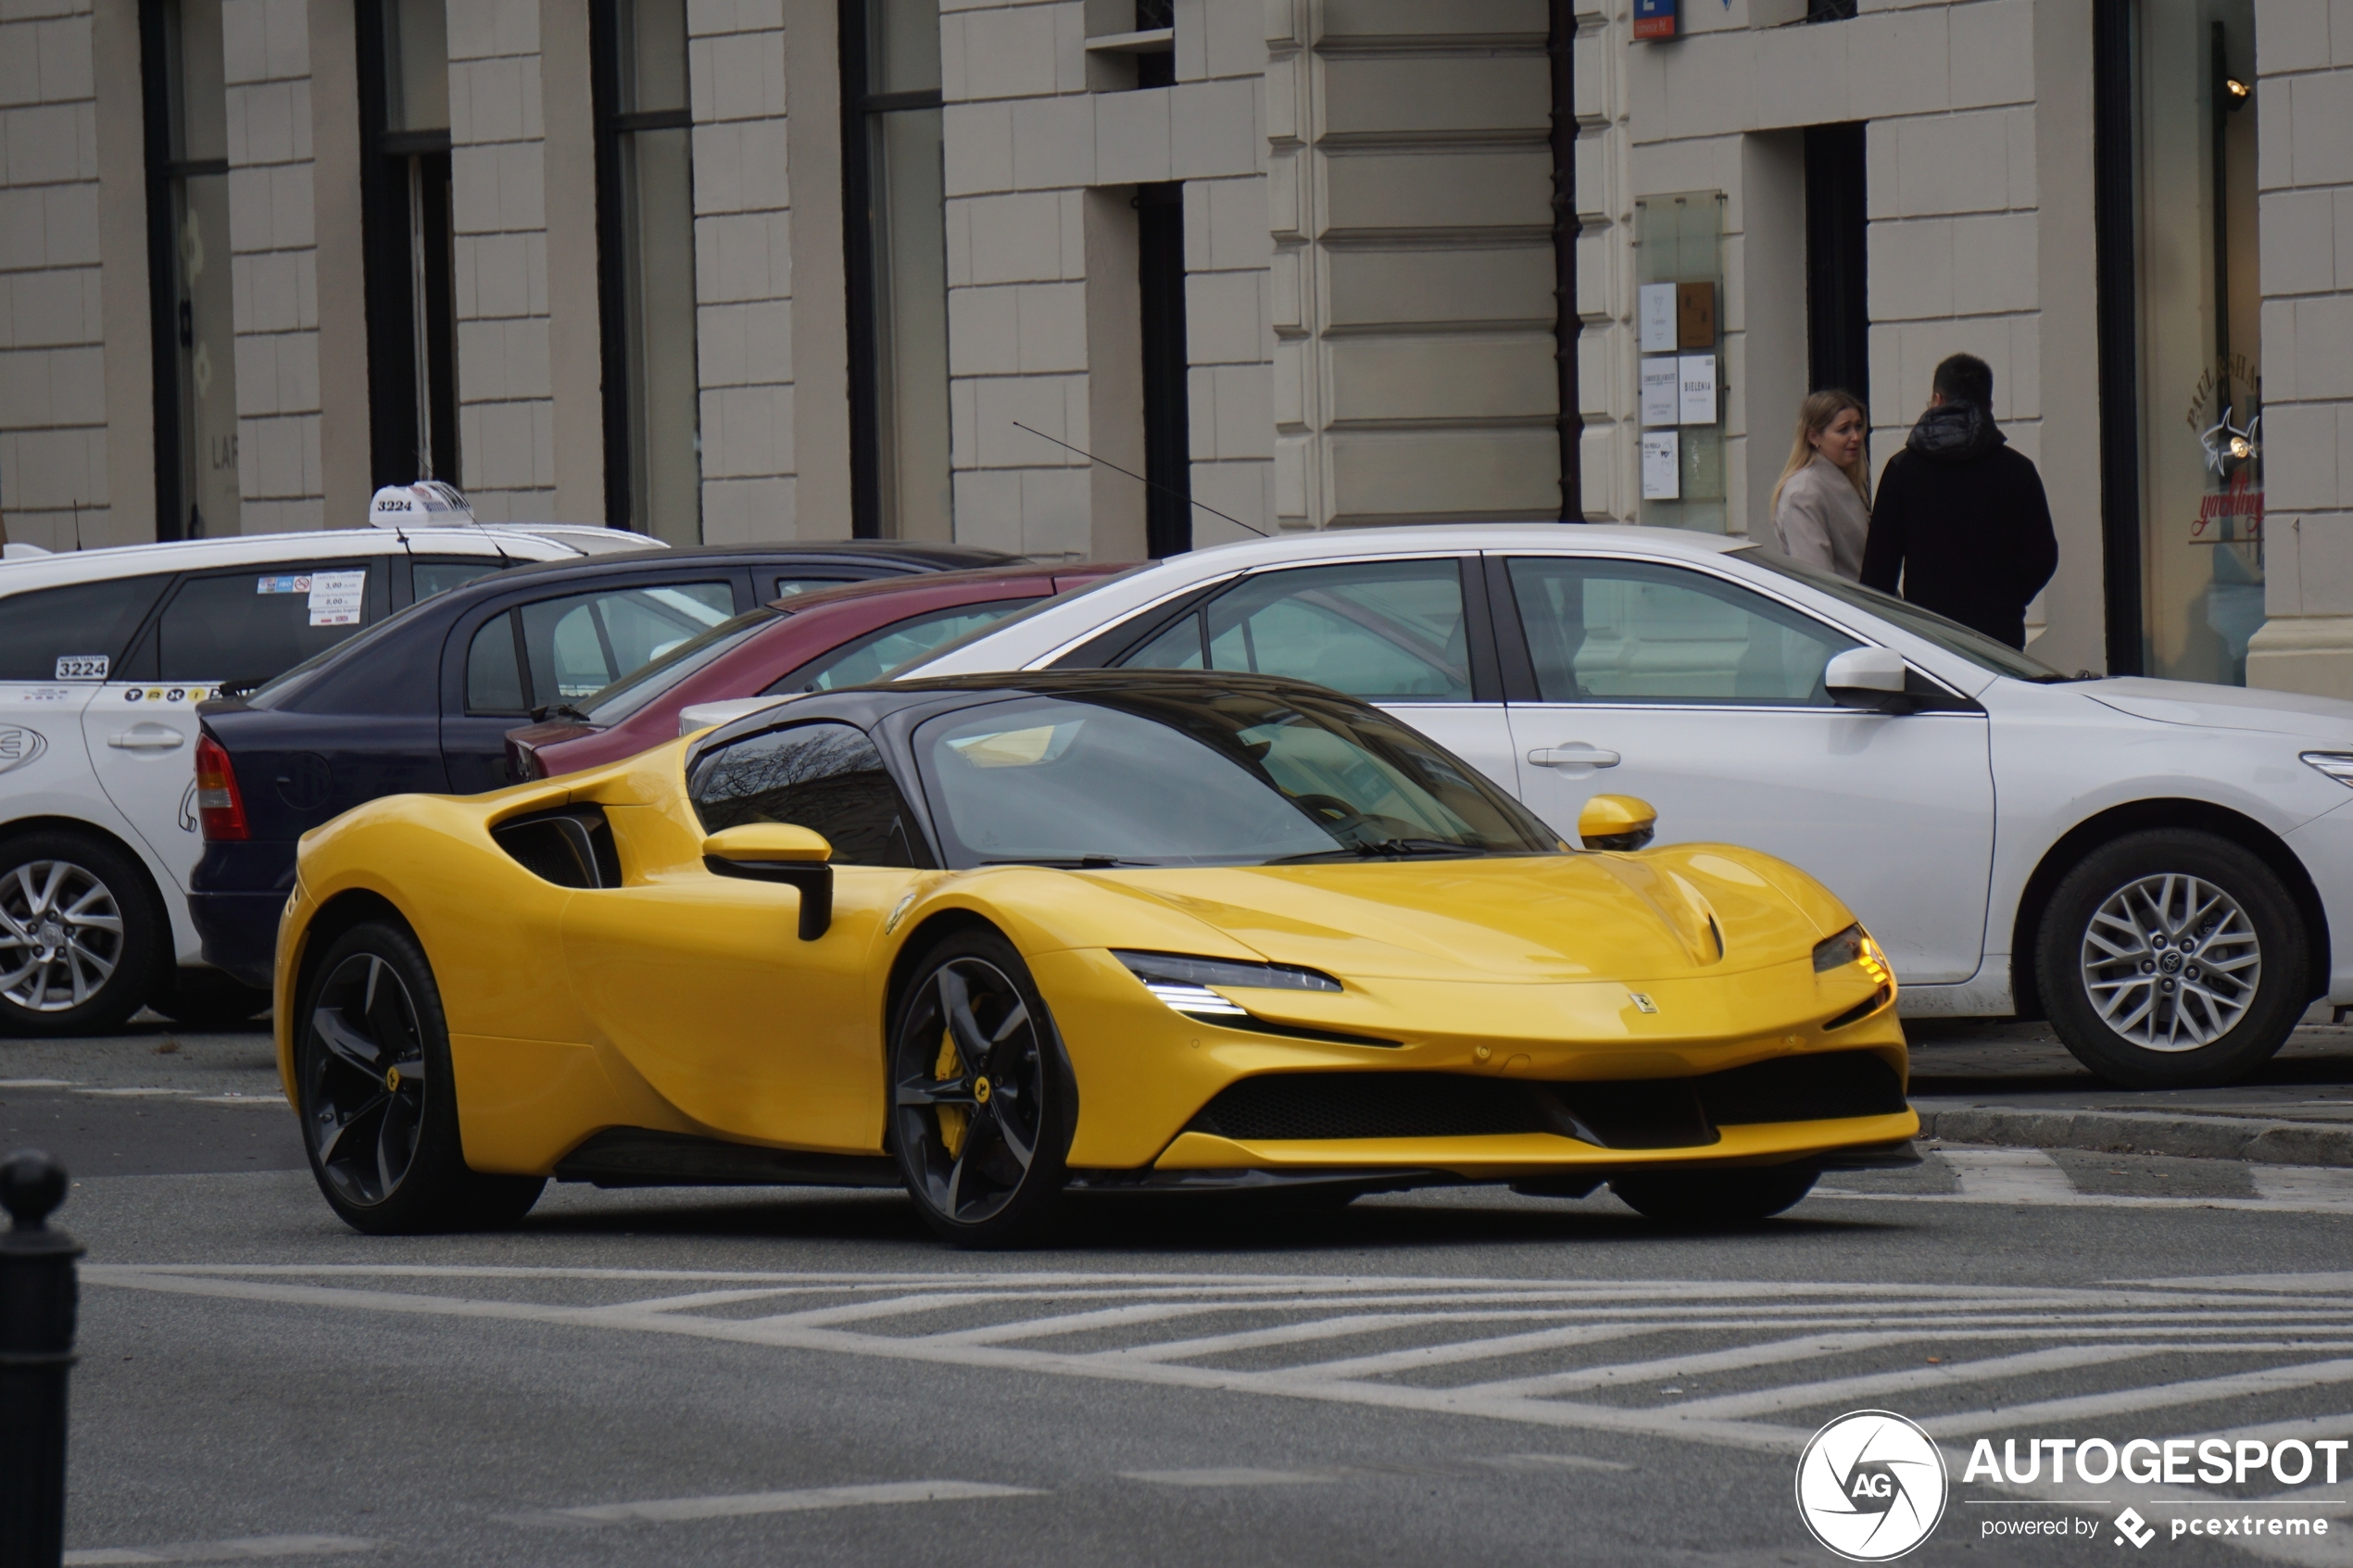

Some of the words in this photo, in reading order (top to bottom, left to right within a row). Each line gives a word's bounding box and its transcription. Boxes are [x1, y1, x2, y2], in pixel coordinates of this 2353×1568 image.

[1684, 381, 1711, 392] BIELENIA
[2187, 367, 2215, 433] PAUL
[377, 500, 413, 512] 3224
[2191, 470, 2265, 537] yachting
[58, 662, 106, 676] 3224
[126, 689, 204, 701] TAXI
